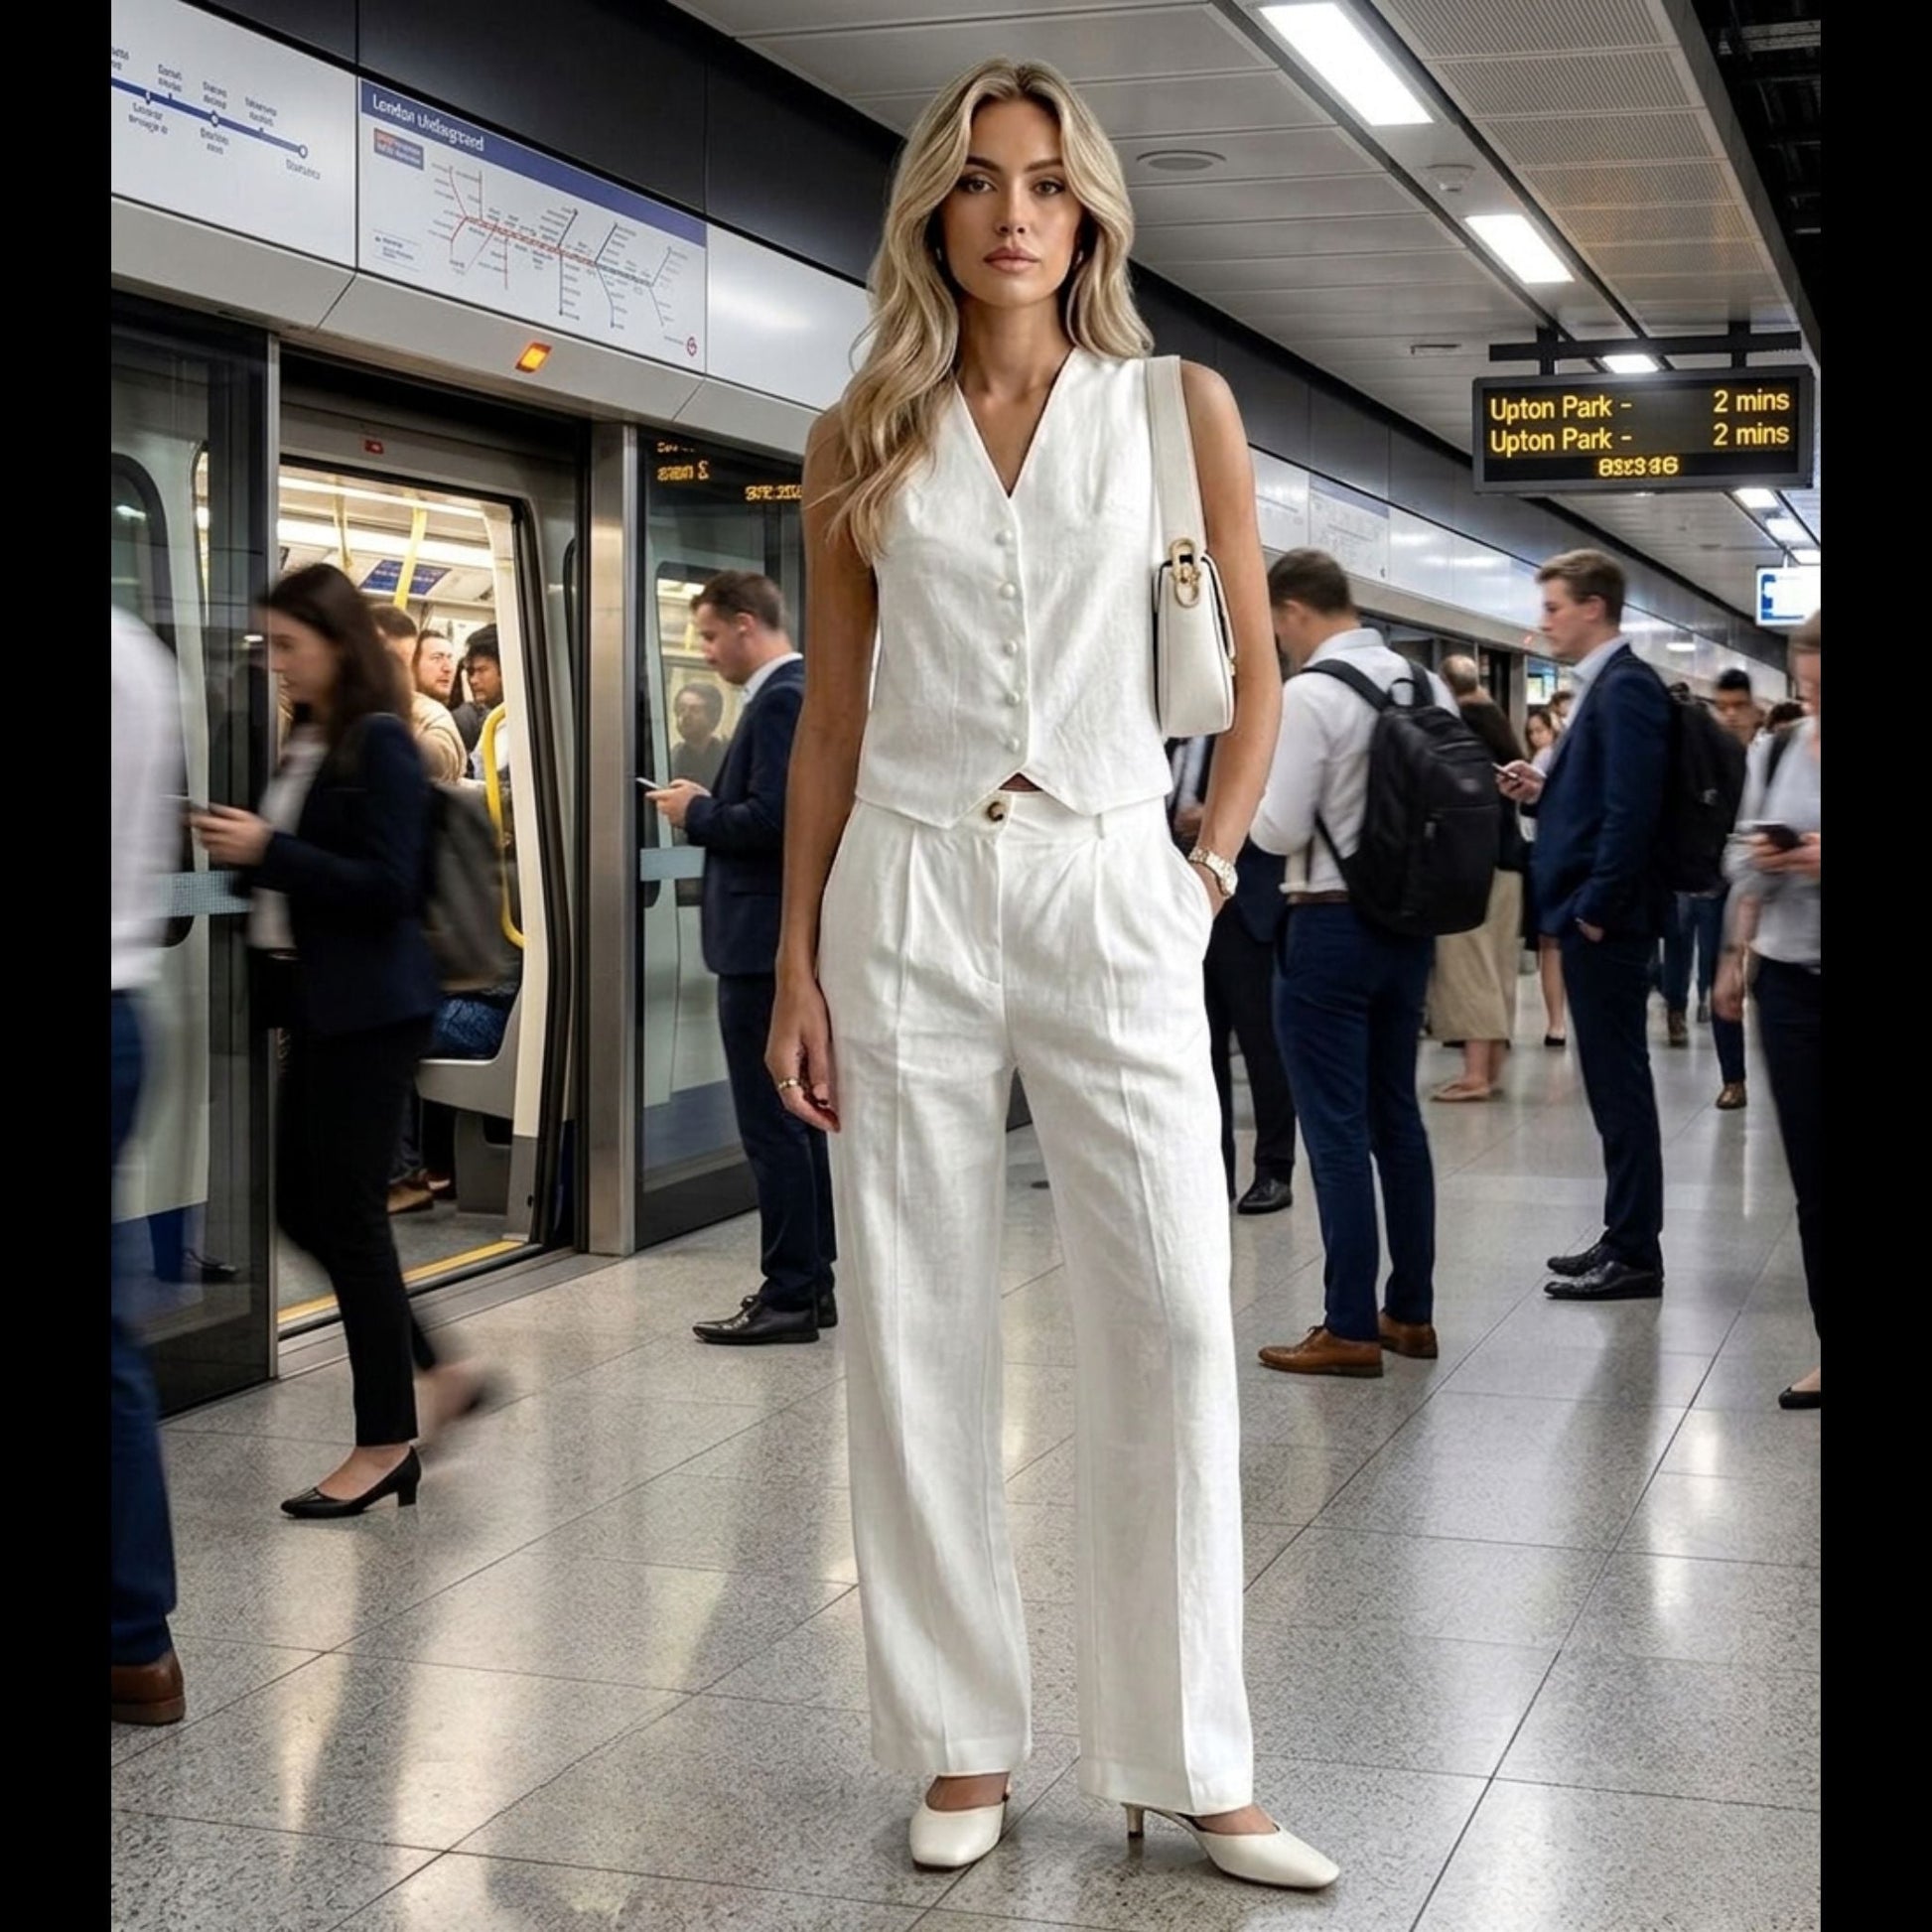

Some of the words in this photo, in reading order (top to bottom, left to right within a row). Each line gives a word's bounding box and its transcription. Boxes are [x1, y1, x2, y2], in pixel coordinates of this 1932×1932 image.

[1490, 397, 1555, 425] Upton
[1563, 394, 1612, 417] Park
[1714, 389, 1728, 412] 2
[1735, 387, 1790, 412] mins
[1490, 430, 1555, 458] Upton
[1563, 427, 1612, 450] Park
[1714, 423, 1728, 446] 2
[1735, 421, 1790, 445] mins
